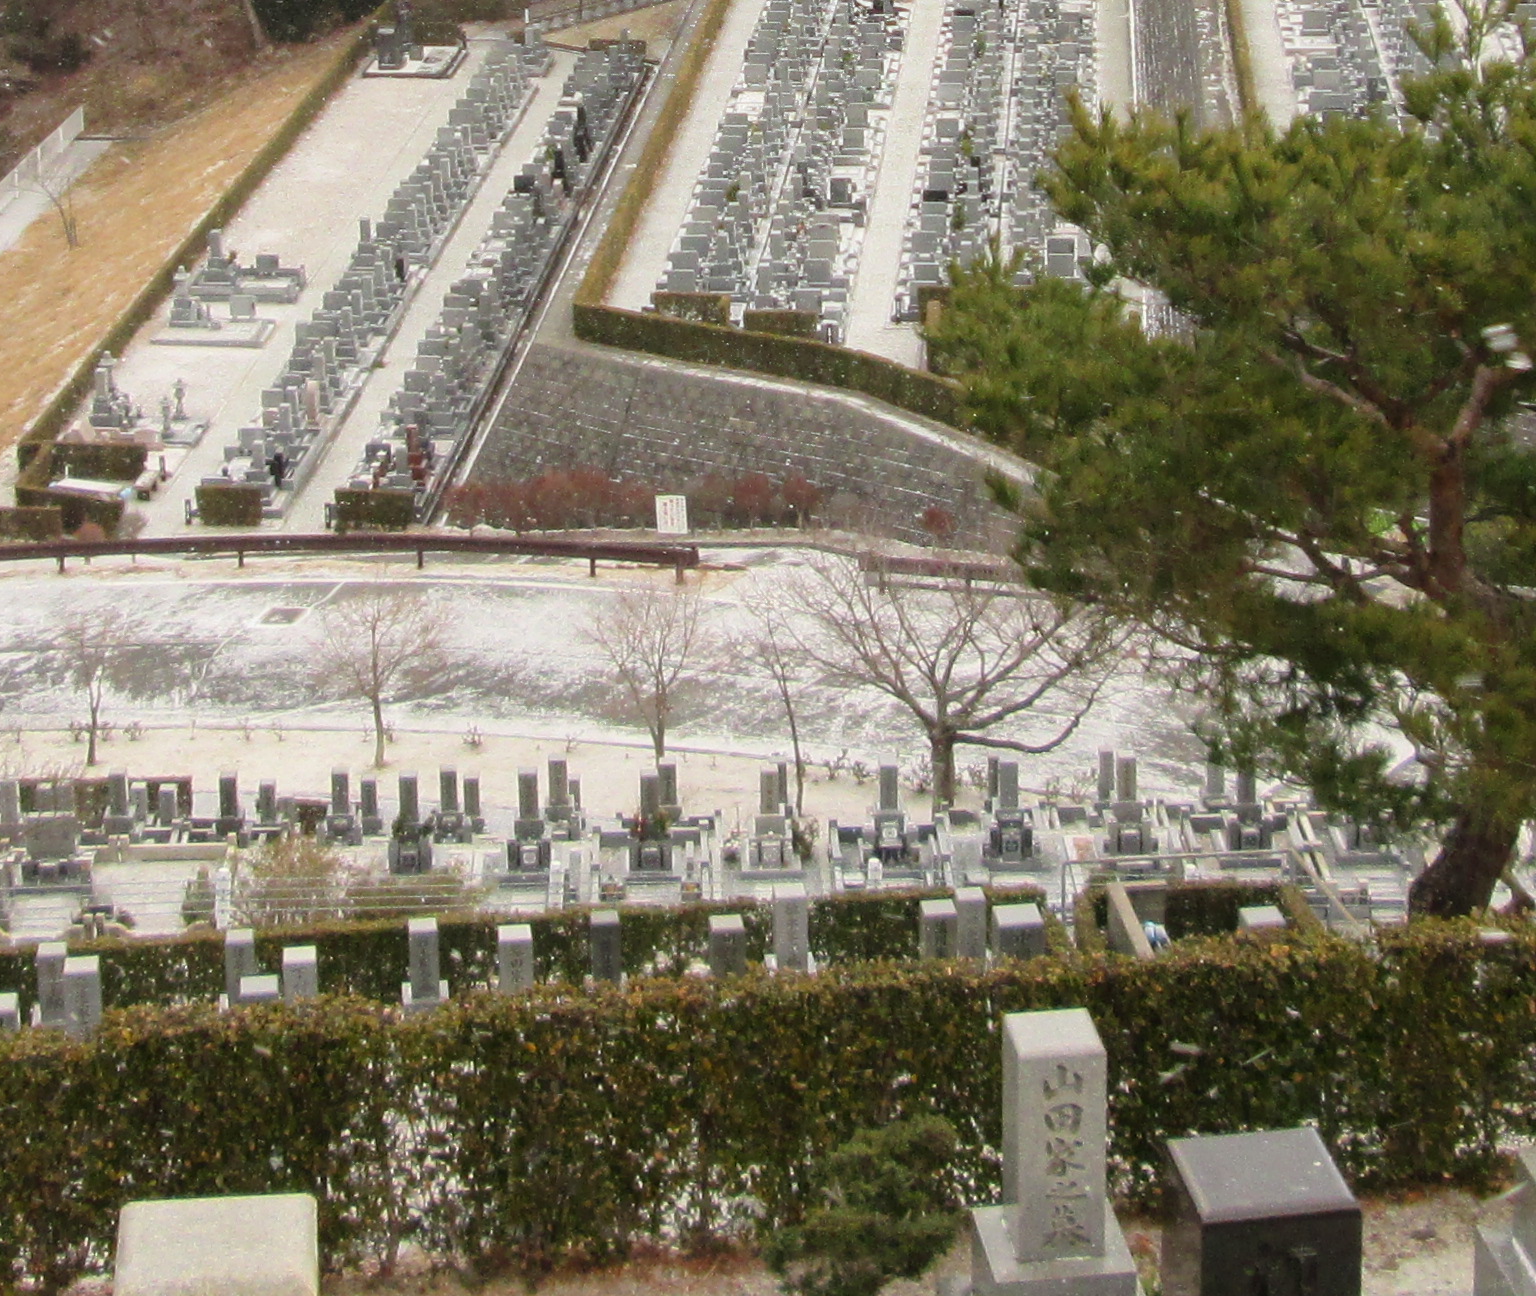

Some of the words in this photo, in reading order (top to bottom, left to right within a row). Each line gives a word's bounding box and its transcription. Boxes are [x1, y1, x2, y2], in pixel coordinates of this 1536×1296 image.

[1041, 1063, 1093, 1250] 山田家之墓
